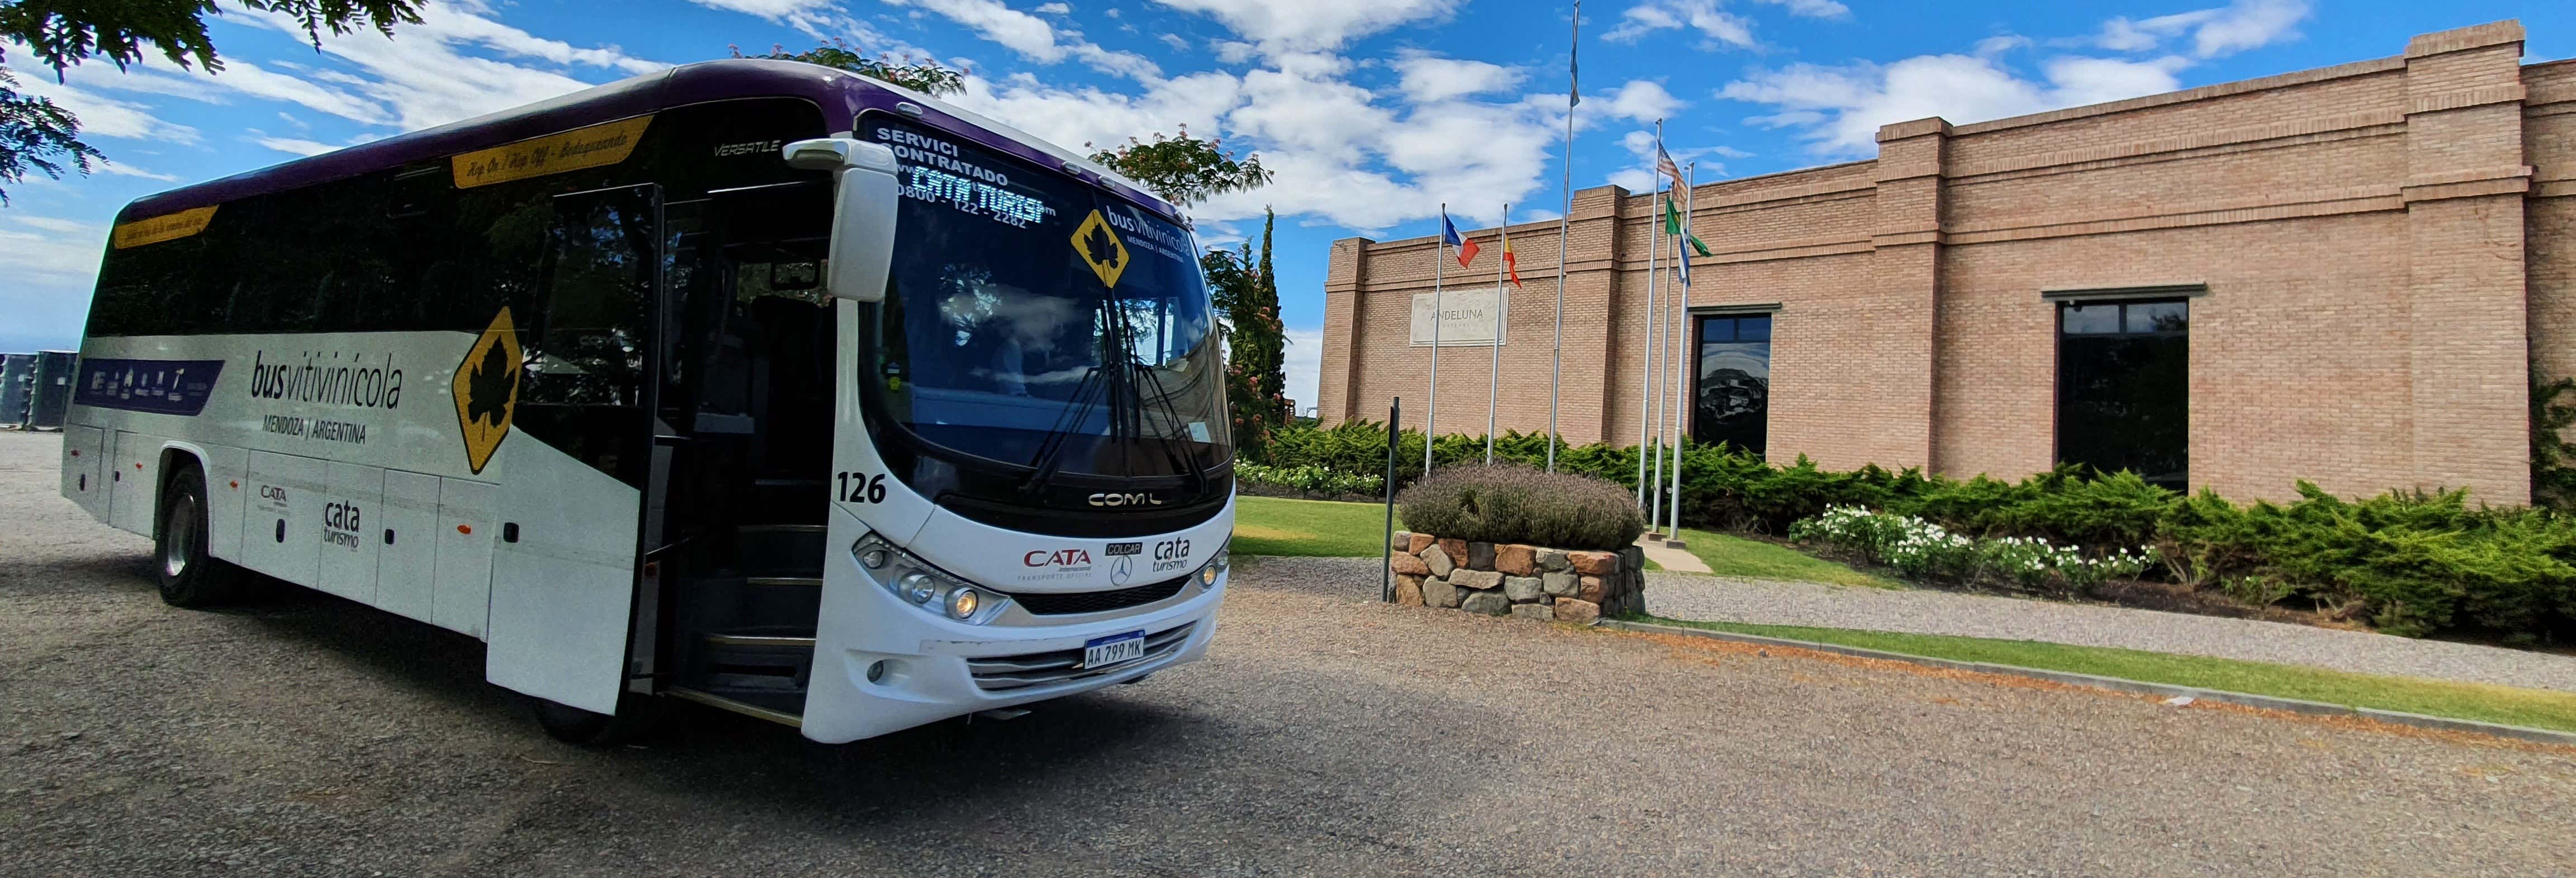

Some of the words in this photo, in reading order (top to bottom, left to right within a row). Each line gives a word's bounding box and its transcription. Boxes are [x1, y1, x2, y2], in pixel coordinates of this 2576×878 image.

[714, 140, 782, 156] VERSATILE
[877, 128, 958, 156] SERVICI
[880, 143, 1008, 186] ONTRATADO
[911, 166, 971, 201] CATA
[953, 200, 978, 215] 122
[993, 210, 1026, 229] 2282
[1127, 235, 1154, 251] MENDOZA
[1431, 309, 1483, 321] ANDELUNA
[263, 415, 304, 436] MENDOZA
[312, 419, 366, 444] ARGENTINA
[261, 485, 286, 502] CATA
[837, 472, 886, 504] 126
[325, 499, 360, 533] cata
[324, 526, 359, 548] turismo
[1107, 543, 1140, 554] COLCAR
[1024, 549, 1091, 567] CATA
[1154, 537, 1190, 561] cata
[1017, 573, 1063, 582] TRANSPORTE
[1152, 559, 1187, 573] turismo
[1087, 648, 1100, 666] AA
[1105, 643, 1125, 662] 799
[1128, 639, 1141, 656] MK
